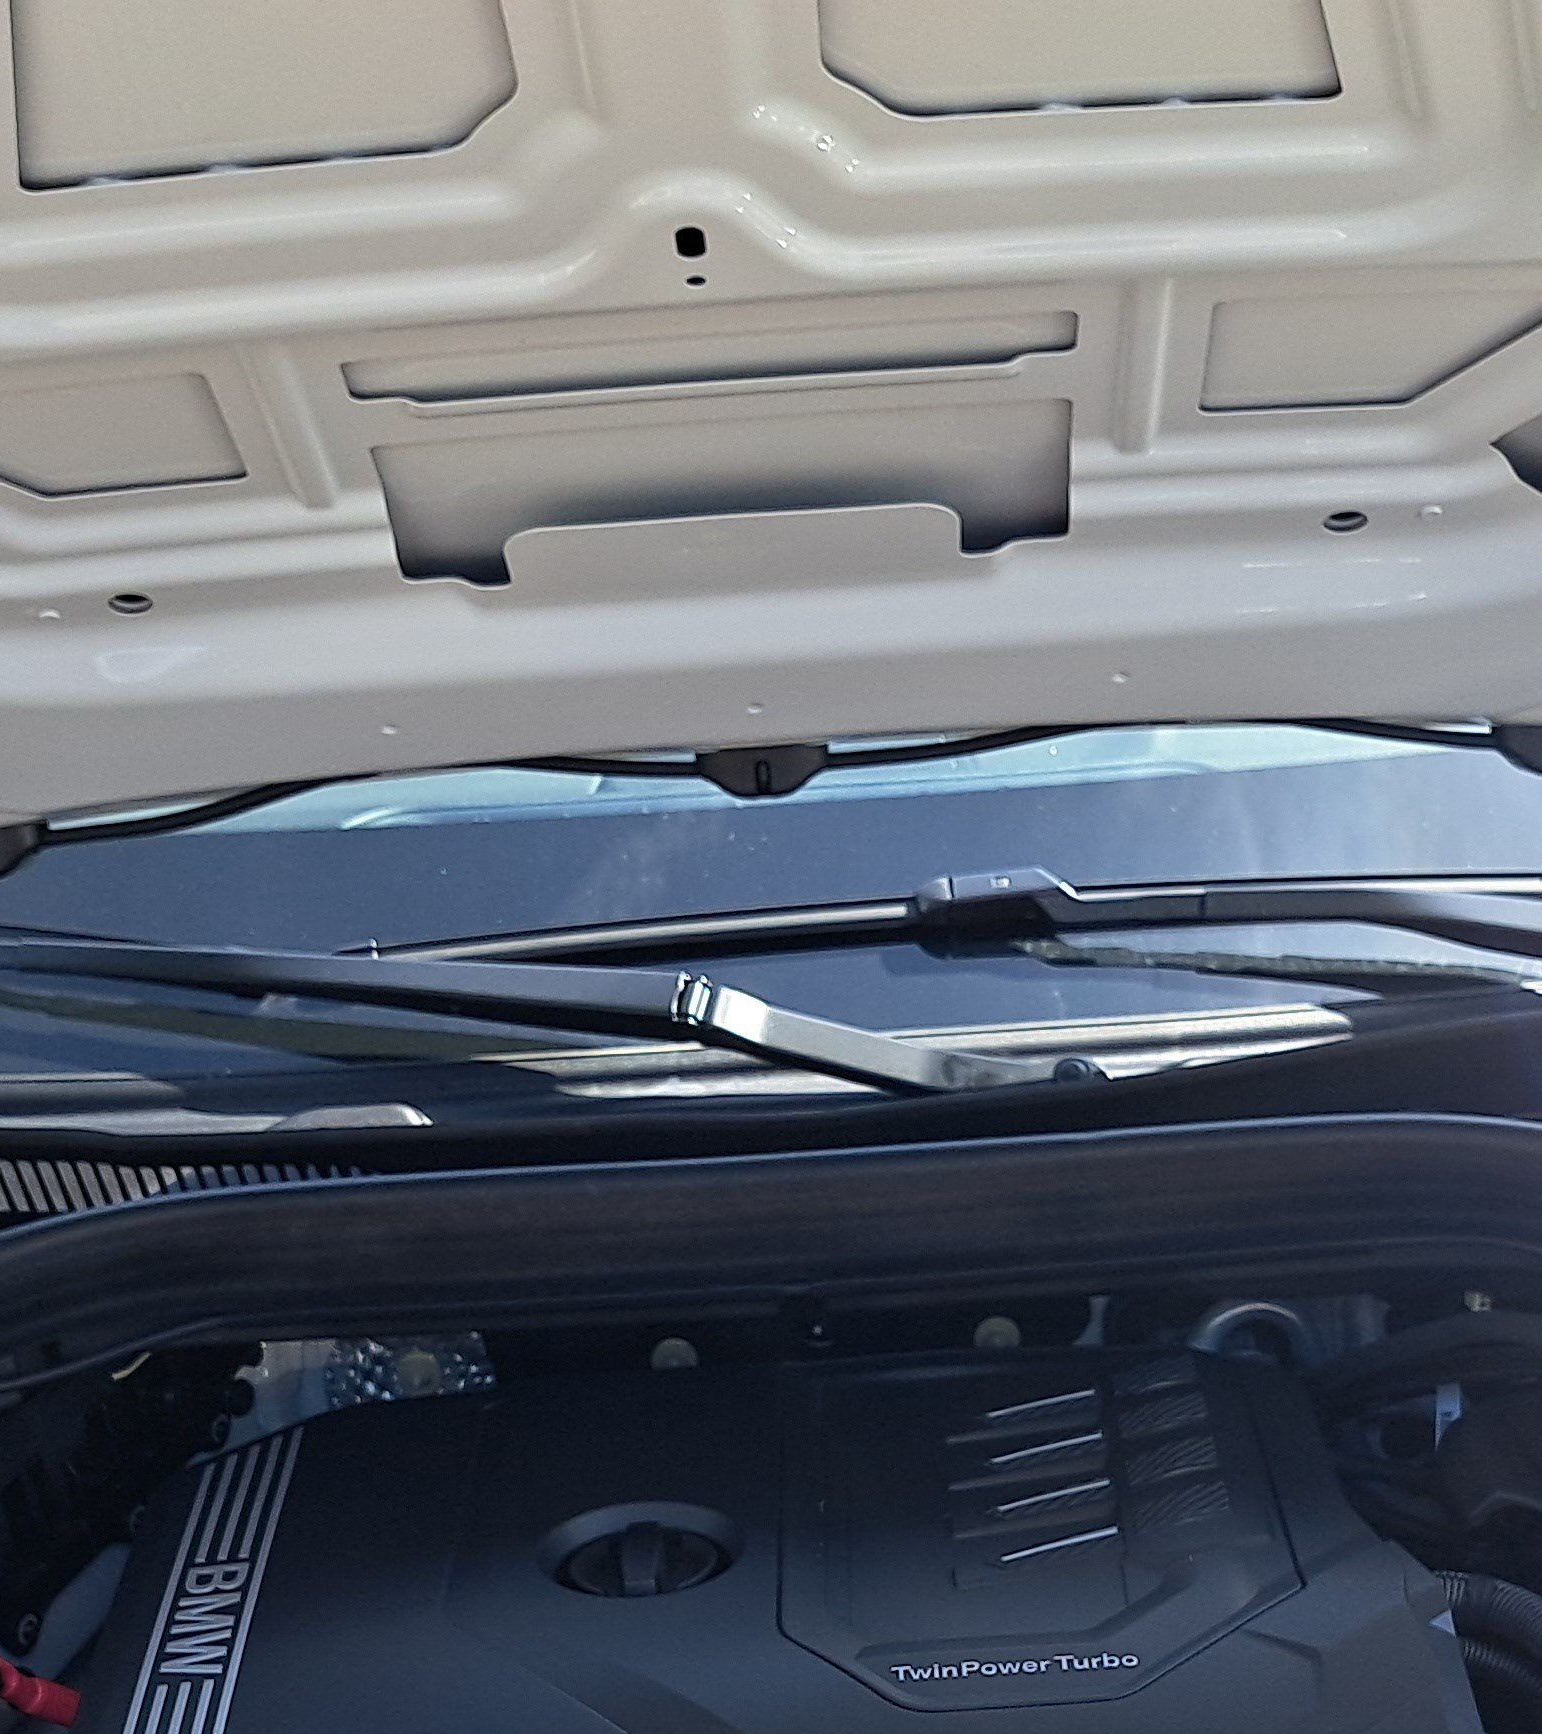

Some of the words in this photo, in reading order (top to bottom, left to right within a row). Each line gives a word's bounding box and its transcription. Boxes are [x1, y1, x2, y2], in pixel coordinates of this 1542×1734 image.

[158, 1561, 250, 1675] BMW
[891, 1658, 1052, 1681] TwinPower
[1054, 1652, 1140, 1672] Turbo
